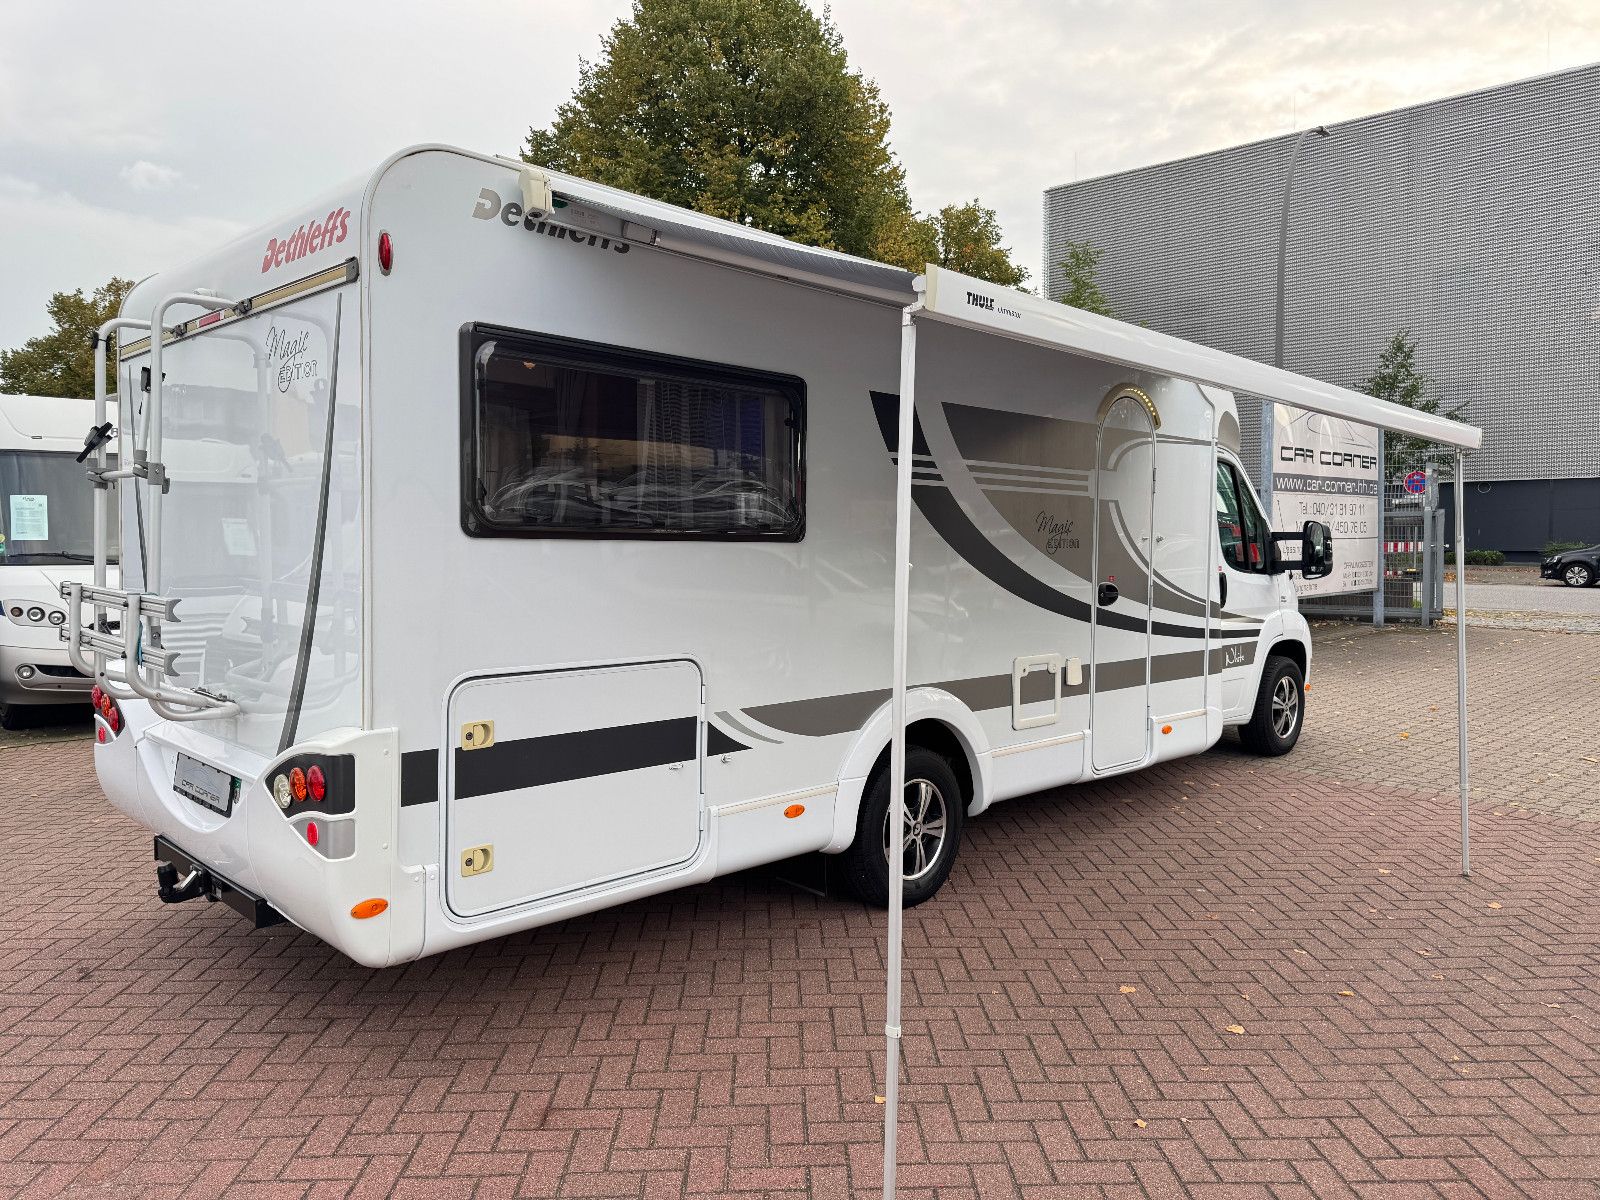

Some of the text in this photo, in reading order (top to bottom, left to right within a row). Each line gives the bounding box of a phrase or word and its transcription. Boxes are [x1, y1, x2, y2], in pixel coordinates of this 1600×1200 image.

[261, 207, 350, 273] Dethleffs
[966, 291, 995, 311] THULE
[266, 326, 309, 361] Magic
[1281, 446, 1377, 470] CAR CORNER
[1276, 477, 1378, 494] www.car-corner-hh.de
[1035, 510, 1074, 536] Magic
